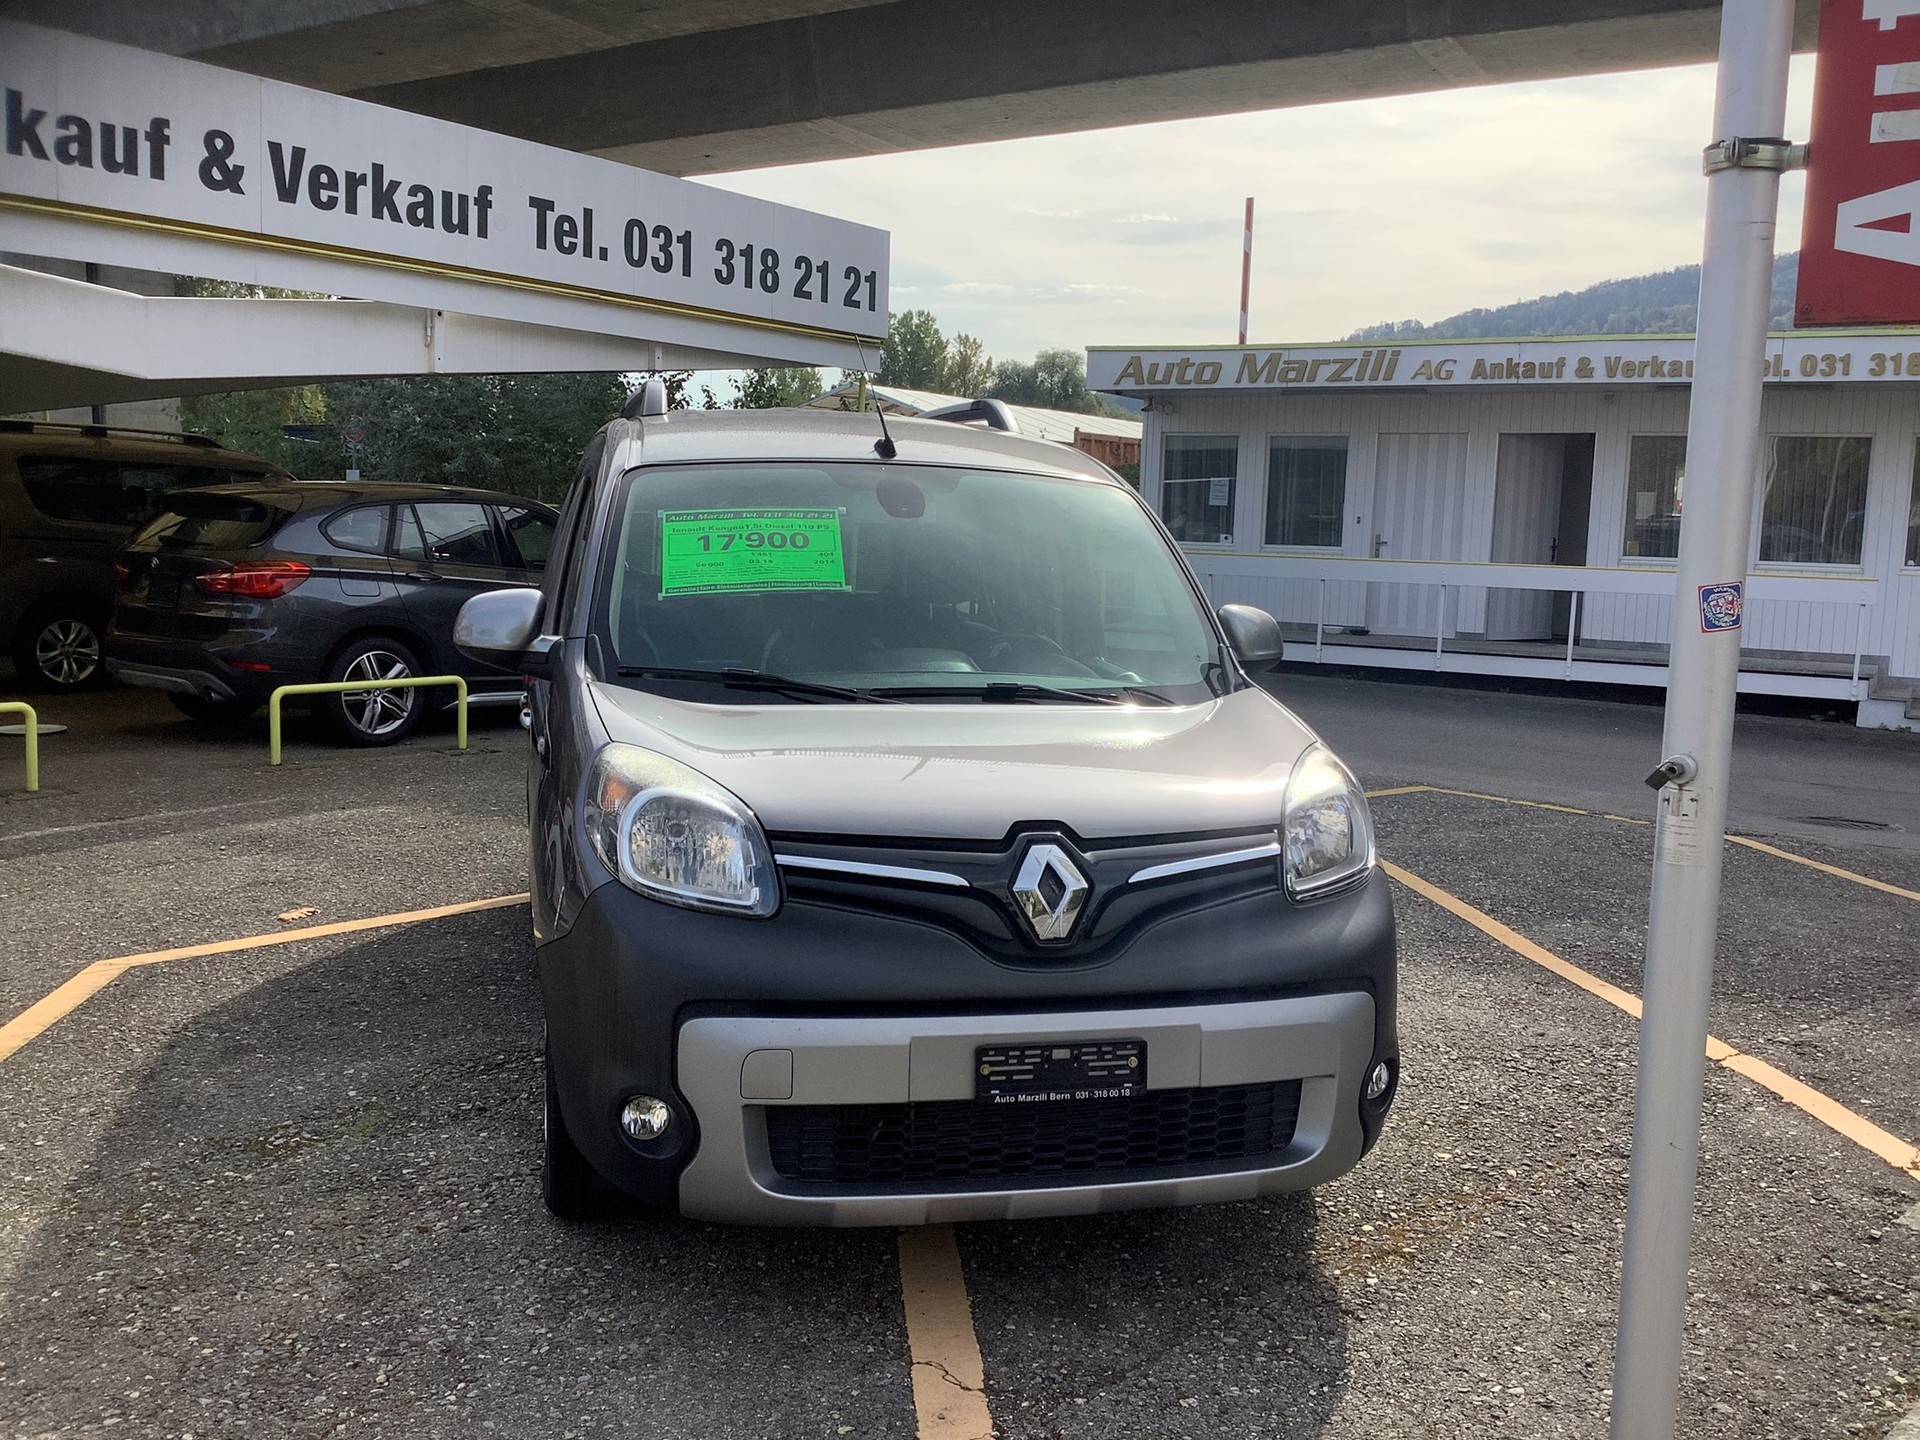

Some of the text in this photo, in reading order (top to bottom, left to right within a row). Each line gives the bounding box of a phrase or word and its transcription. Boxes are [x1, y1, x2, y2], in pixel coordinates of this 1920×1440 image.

[5, 87, 877, 312] kauf & Verkauf Tel. 031 318 21 21
[1113, 355, 1223, 385] Auto
[1235, 349, 1402, 384] Marzili
[1410, 358, 1458, 381] AG
[1471, 356, 1567, 380] Ankauf
[1574, 356, 1595, 379] &
[1801, 353, 1852, 377] 031
[1869, 352, 1920, 377] 318
[697, 531, 810, 552] 17'900
[994, 1095, 1015, 1103] Auto
[1018, 1093, 1047, 1102] Marzili
[1050, 1092, 1071, 1100] Bern
[1109, 1089, 1119, 1097] 00
[1120, 1088, 1131, 1096] 18
